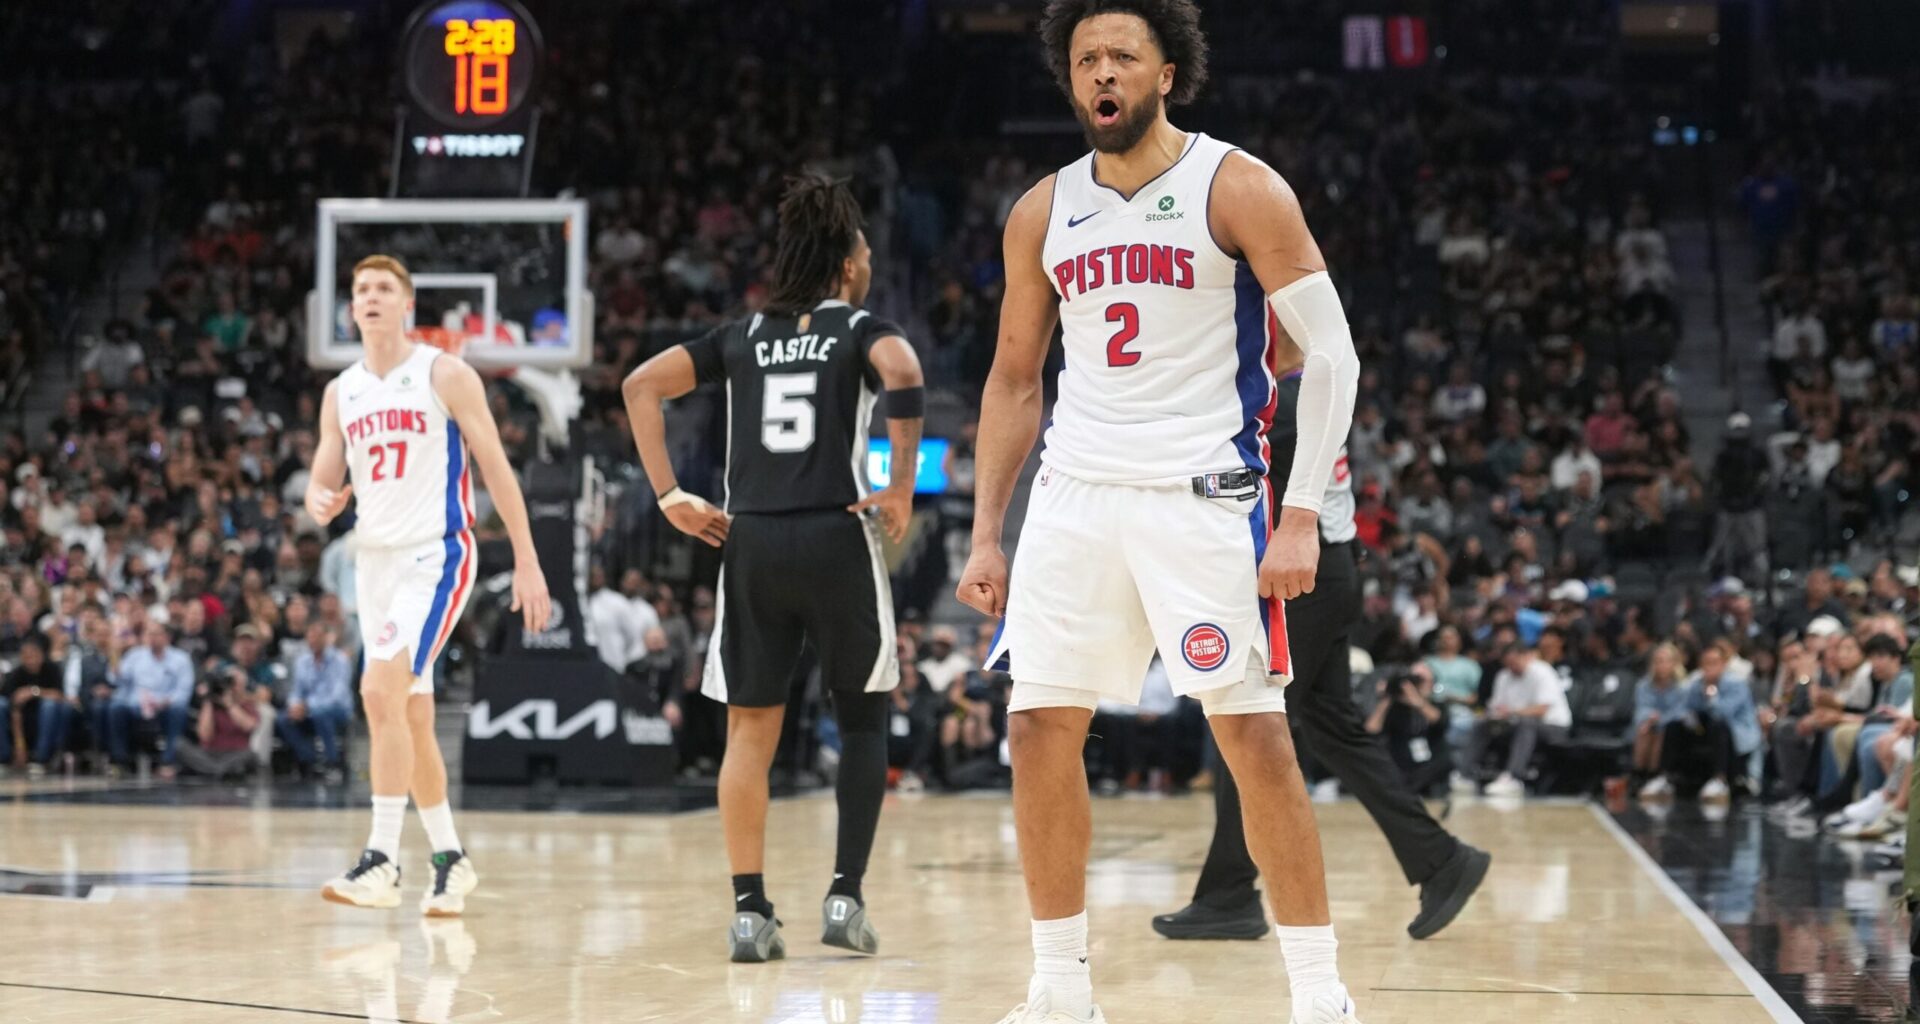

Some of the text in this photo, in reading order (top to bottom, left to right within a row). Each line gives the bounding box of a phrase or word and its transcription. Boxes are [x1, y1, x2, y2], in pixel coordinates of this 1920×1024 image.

[445, 18, 516, 56] 2:28
[455, 54, 509, 115] 18
[1145, 211, 1184, 222] StockX
[1053, 243, 1195, 302] PISTONS
[755, 334, 838, 367] CASTLE
[1105, 302, 1142, 367] 2
[346, 408, 428, 449] PISTONS
[761, 371, 818, 454] 5
[368, 441, 408, 482] 27
[1190, 637, 1219, 650] DETROIT
[1191, 645, 1221, 657] PISTONS
